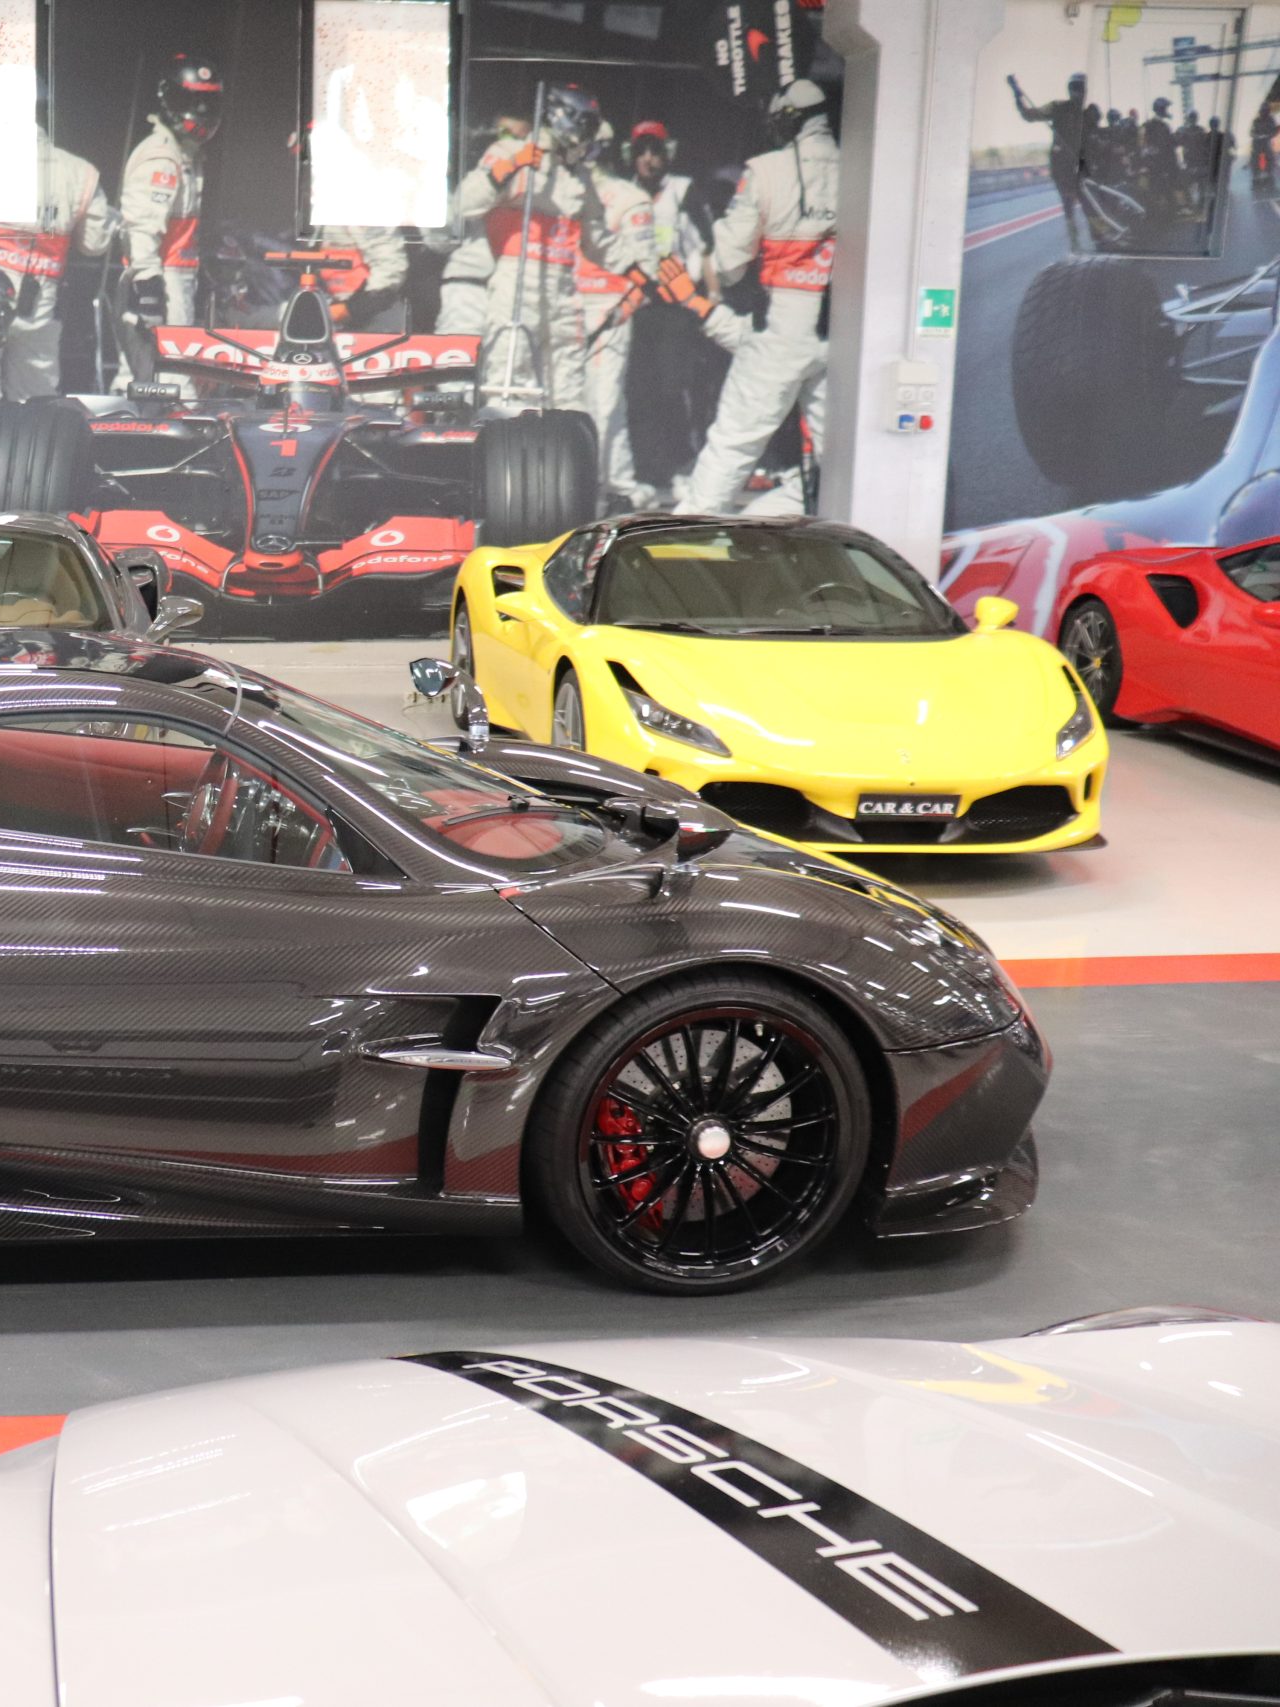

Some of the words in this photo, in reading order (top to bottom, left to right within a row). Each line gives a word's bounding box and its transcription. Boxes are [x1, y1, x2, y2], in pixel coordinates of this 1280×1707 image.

[716, 39, 729, 66] NO
[727, 5, 746, 96] THROTTLE
[775, 0, 795, 87] BRAKES
[351, 554, 453, 570] odafone
[858, 802, 897, 814] CAR
[898, 802, 915, 814] &
[916, 803, 955, 815] CAR
[461, 1360, 980, 1621] PORSCHE
